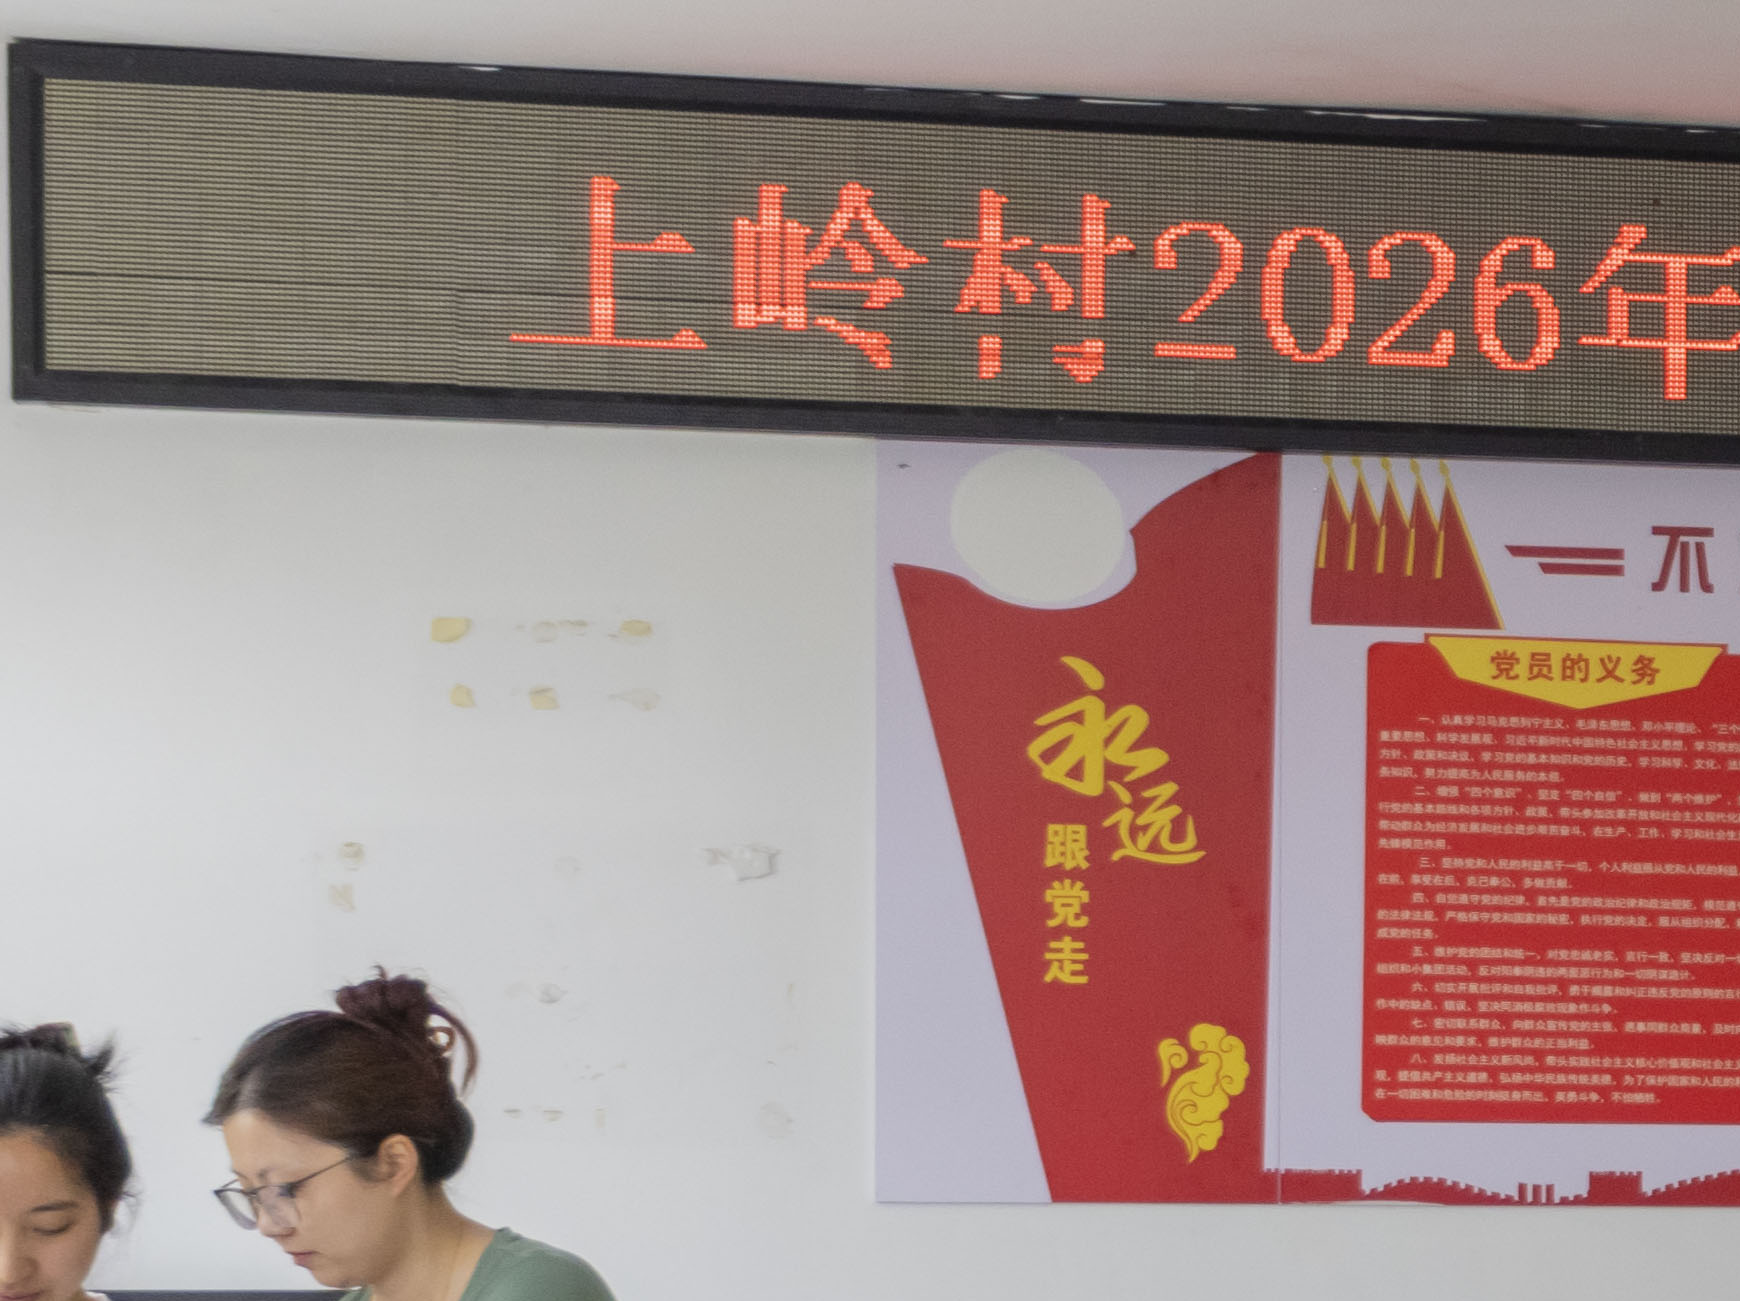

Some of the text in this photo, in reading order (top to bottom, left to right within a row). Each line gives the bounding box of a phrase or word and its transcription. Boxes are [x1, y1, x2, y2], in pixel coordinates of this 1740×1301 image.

[1488, 650, 1662, 687] 党员的义务
[1028, 656, 1206, 863] 永远
[1044, 823, 1090, 985] 跟党走
